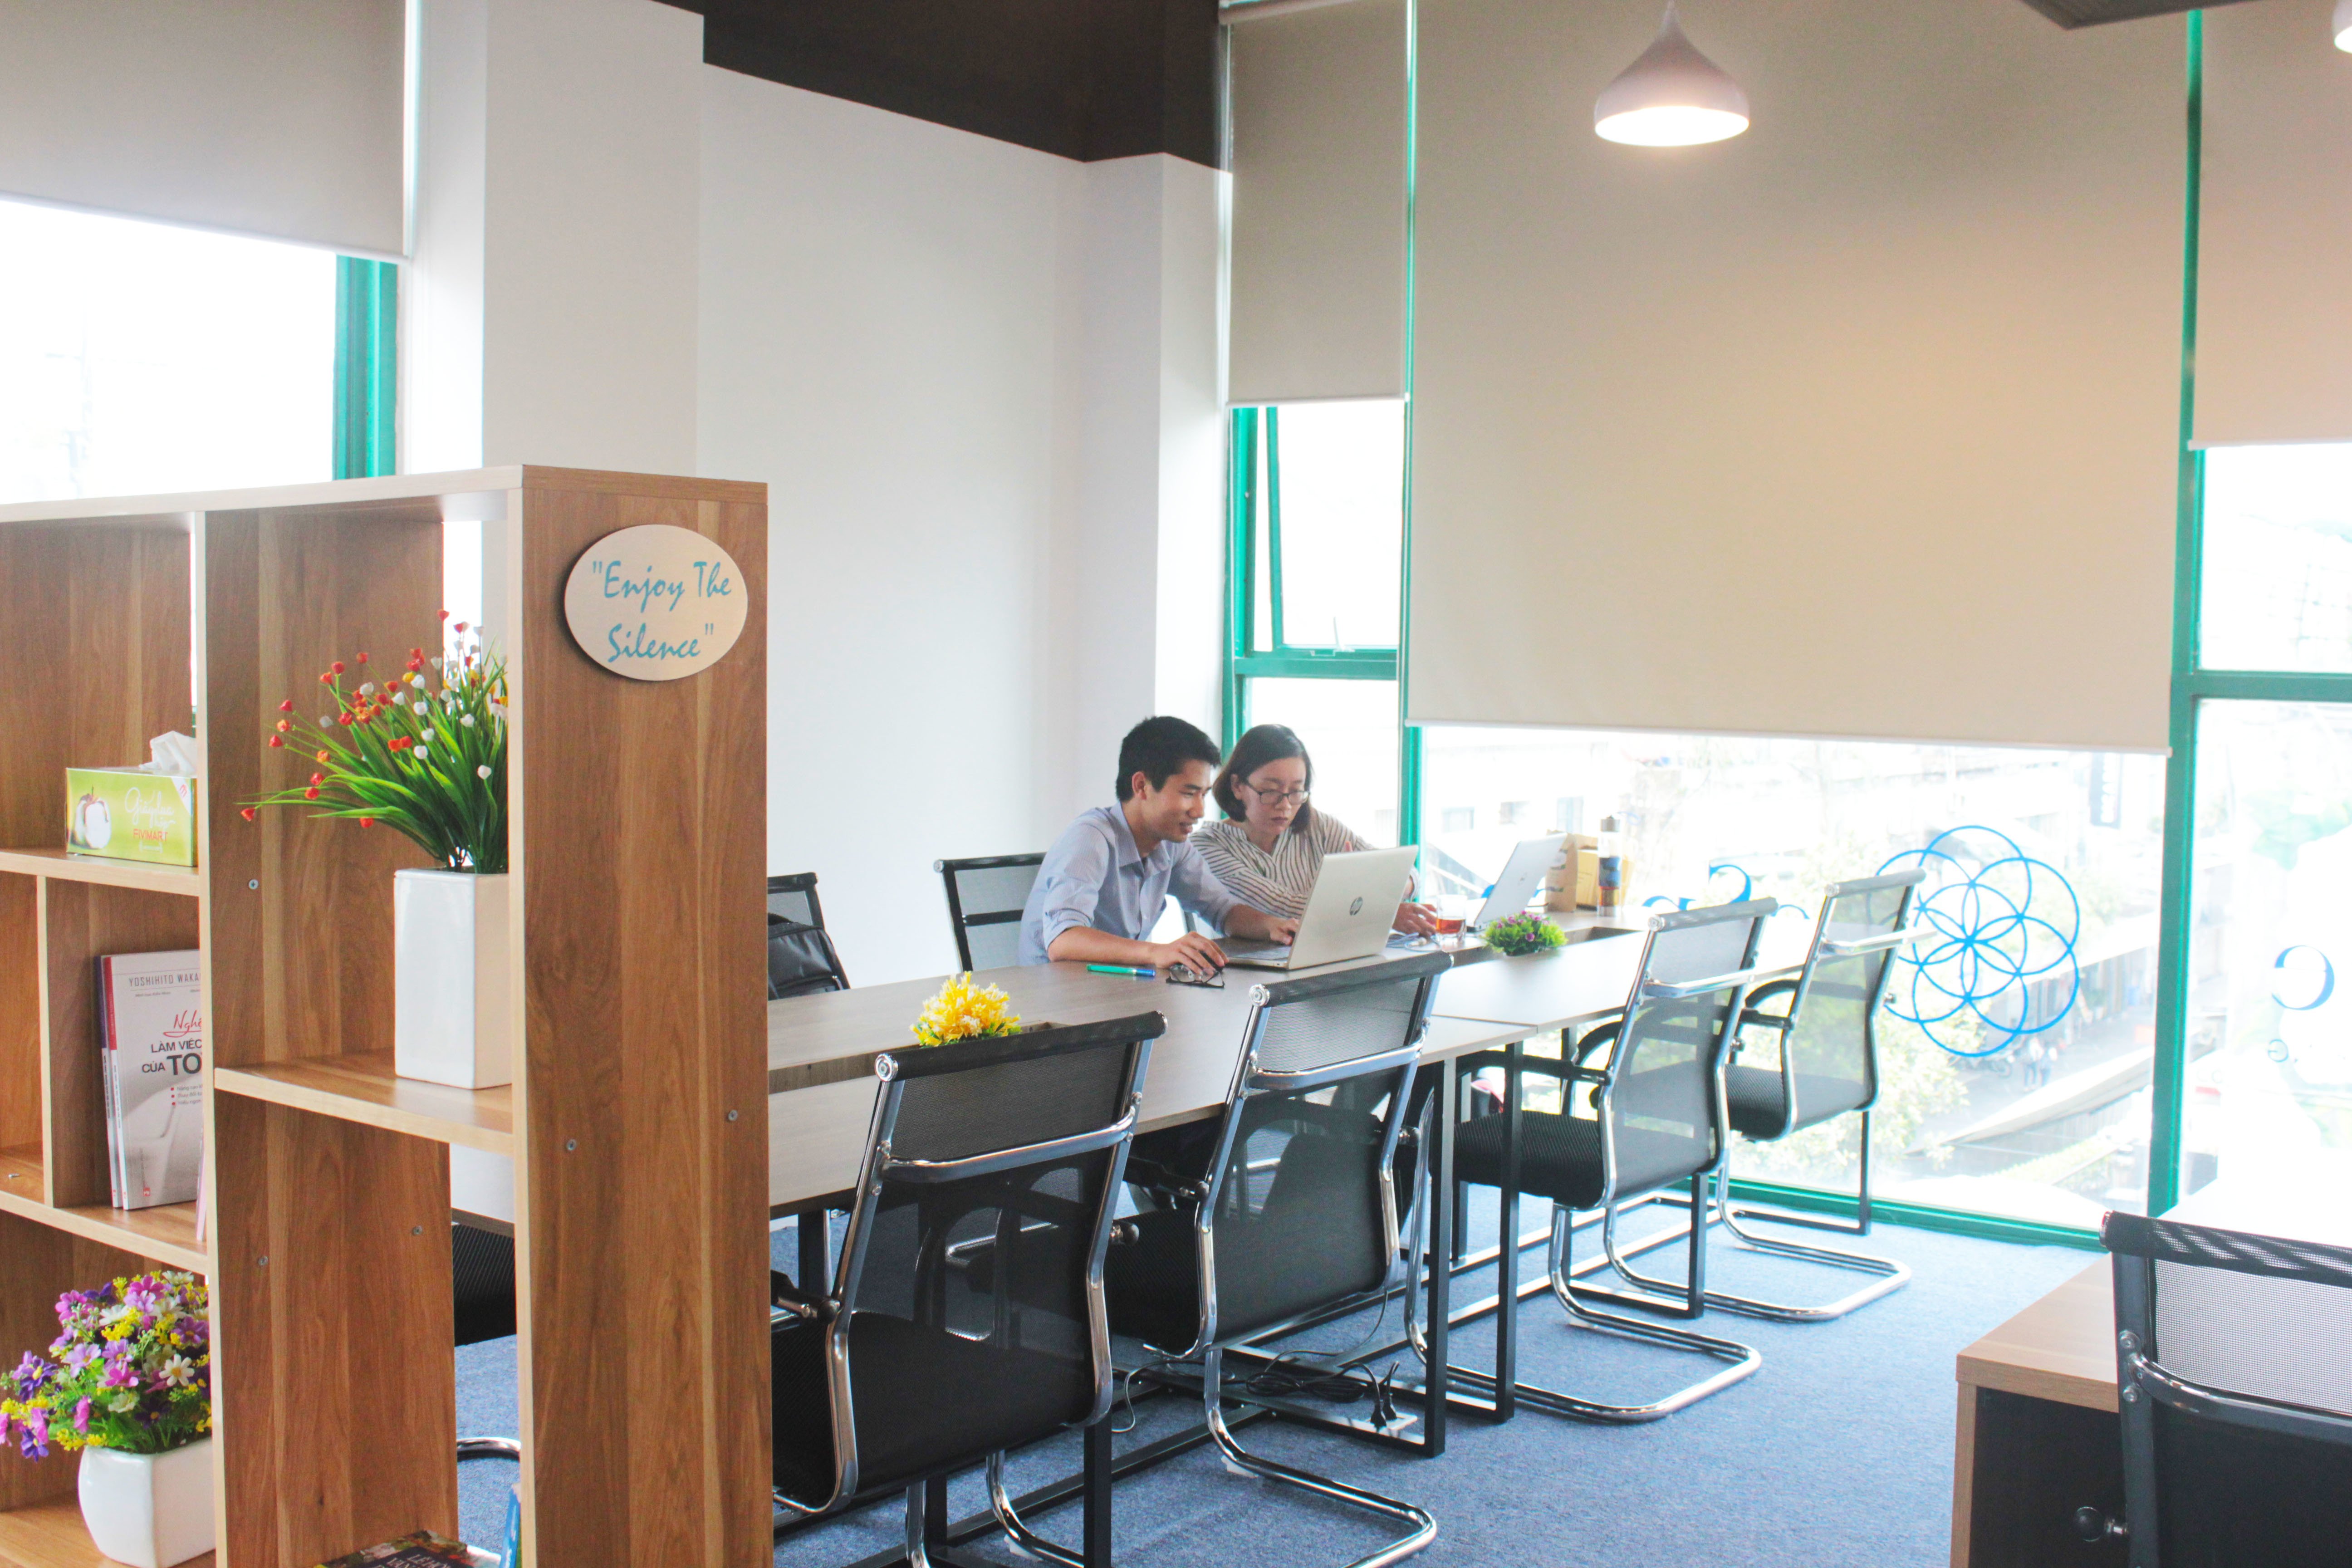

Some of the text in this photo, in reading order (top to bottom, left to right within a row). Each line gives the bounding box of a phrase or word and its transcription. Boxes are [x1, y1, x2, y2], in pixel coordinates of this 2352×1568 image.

[592, 560, 732, 613] "Enjoy The
[608, 622, 714, 663] Silence"
[133, 829, 168, 842] FIVIMART
[129, 972, 201, 987] YOSHIHITO WAKA
[151, 1040, 176, 1053] LÀM
[142, 1051, 203, 1076] CỦA TO
